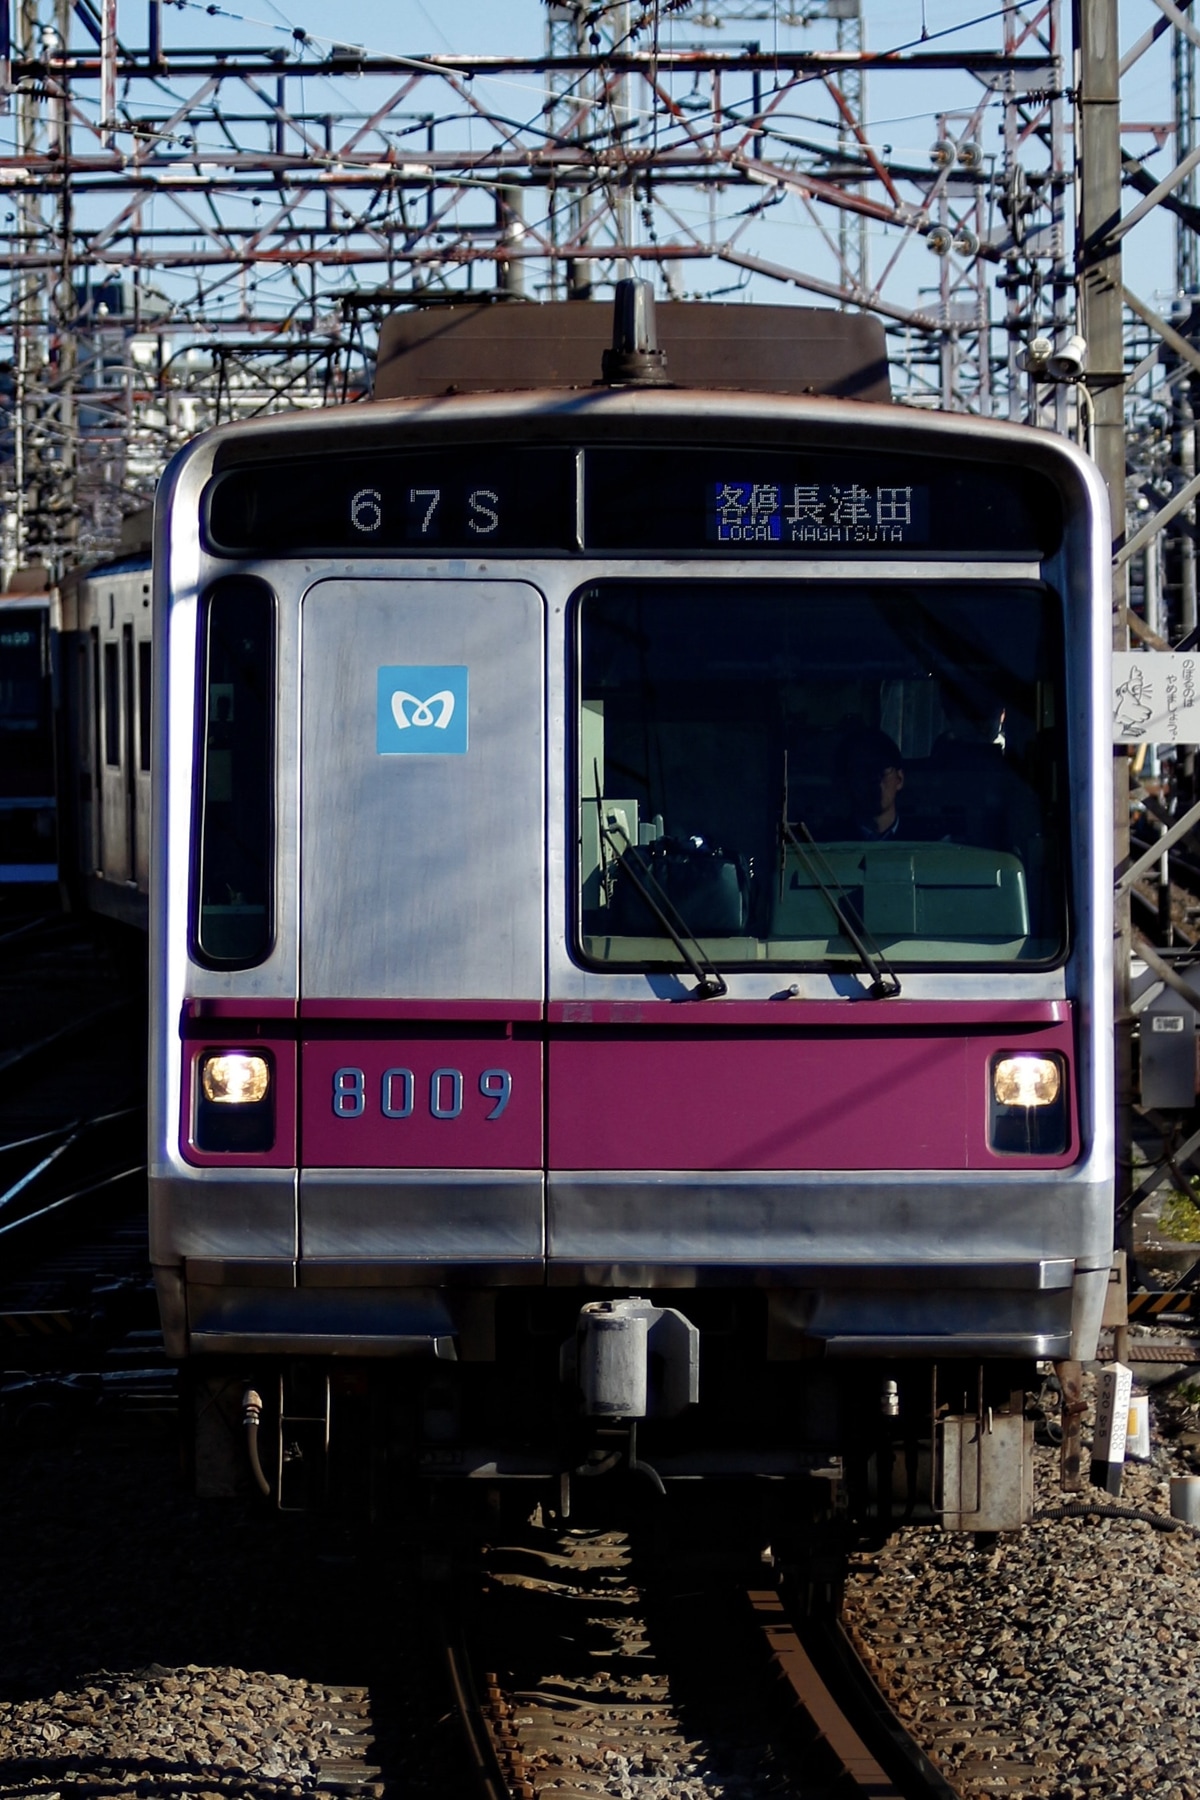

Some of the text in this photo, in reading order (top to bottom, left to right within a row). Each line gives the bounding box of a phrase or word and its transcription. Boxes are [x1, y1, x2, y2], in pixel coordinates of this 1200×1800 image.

[716, 484, 912, 524] 各停 長津田
[717, 525, 904, 542] LOCAL NAGATSUTA
[333, 1067, 512, 1120] 8009
